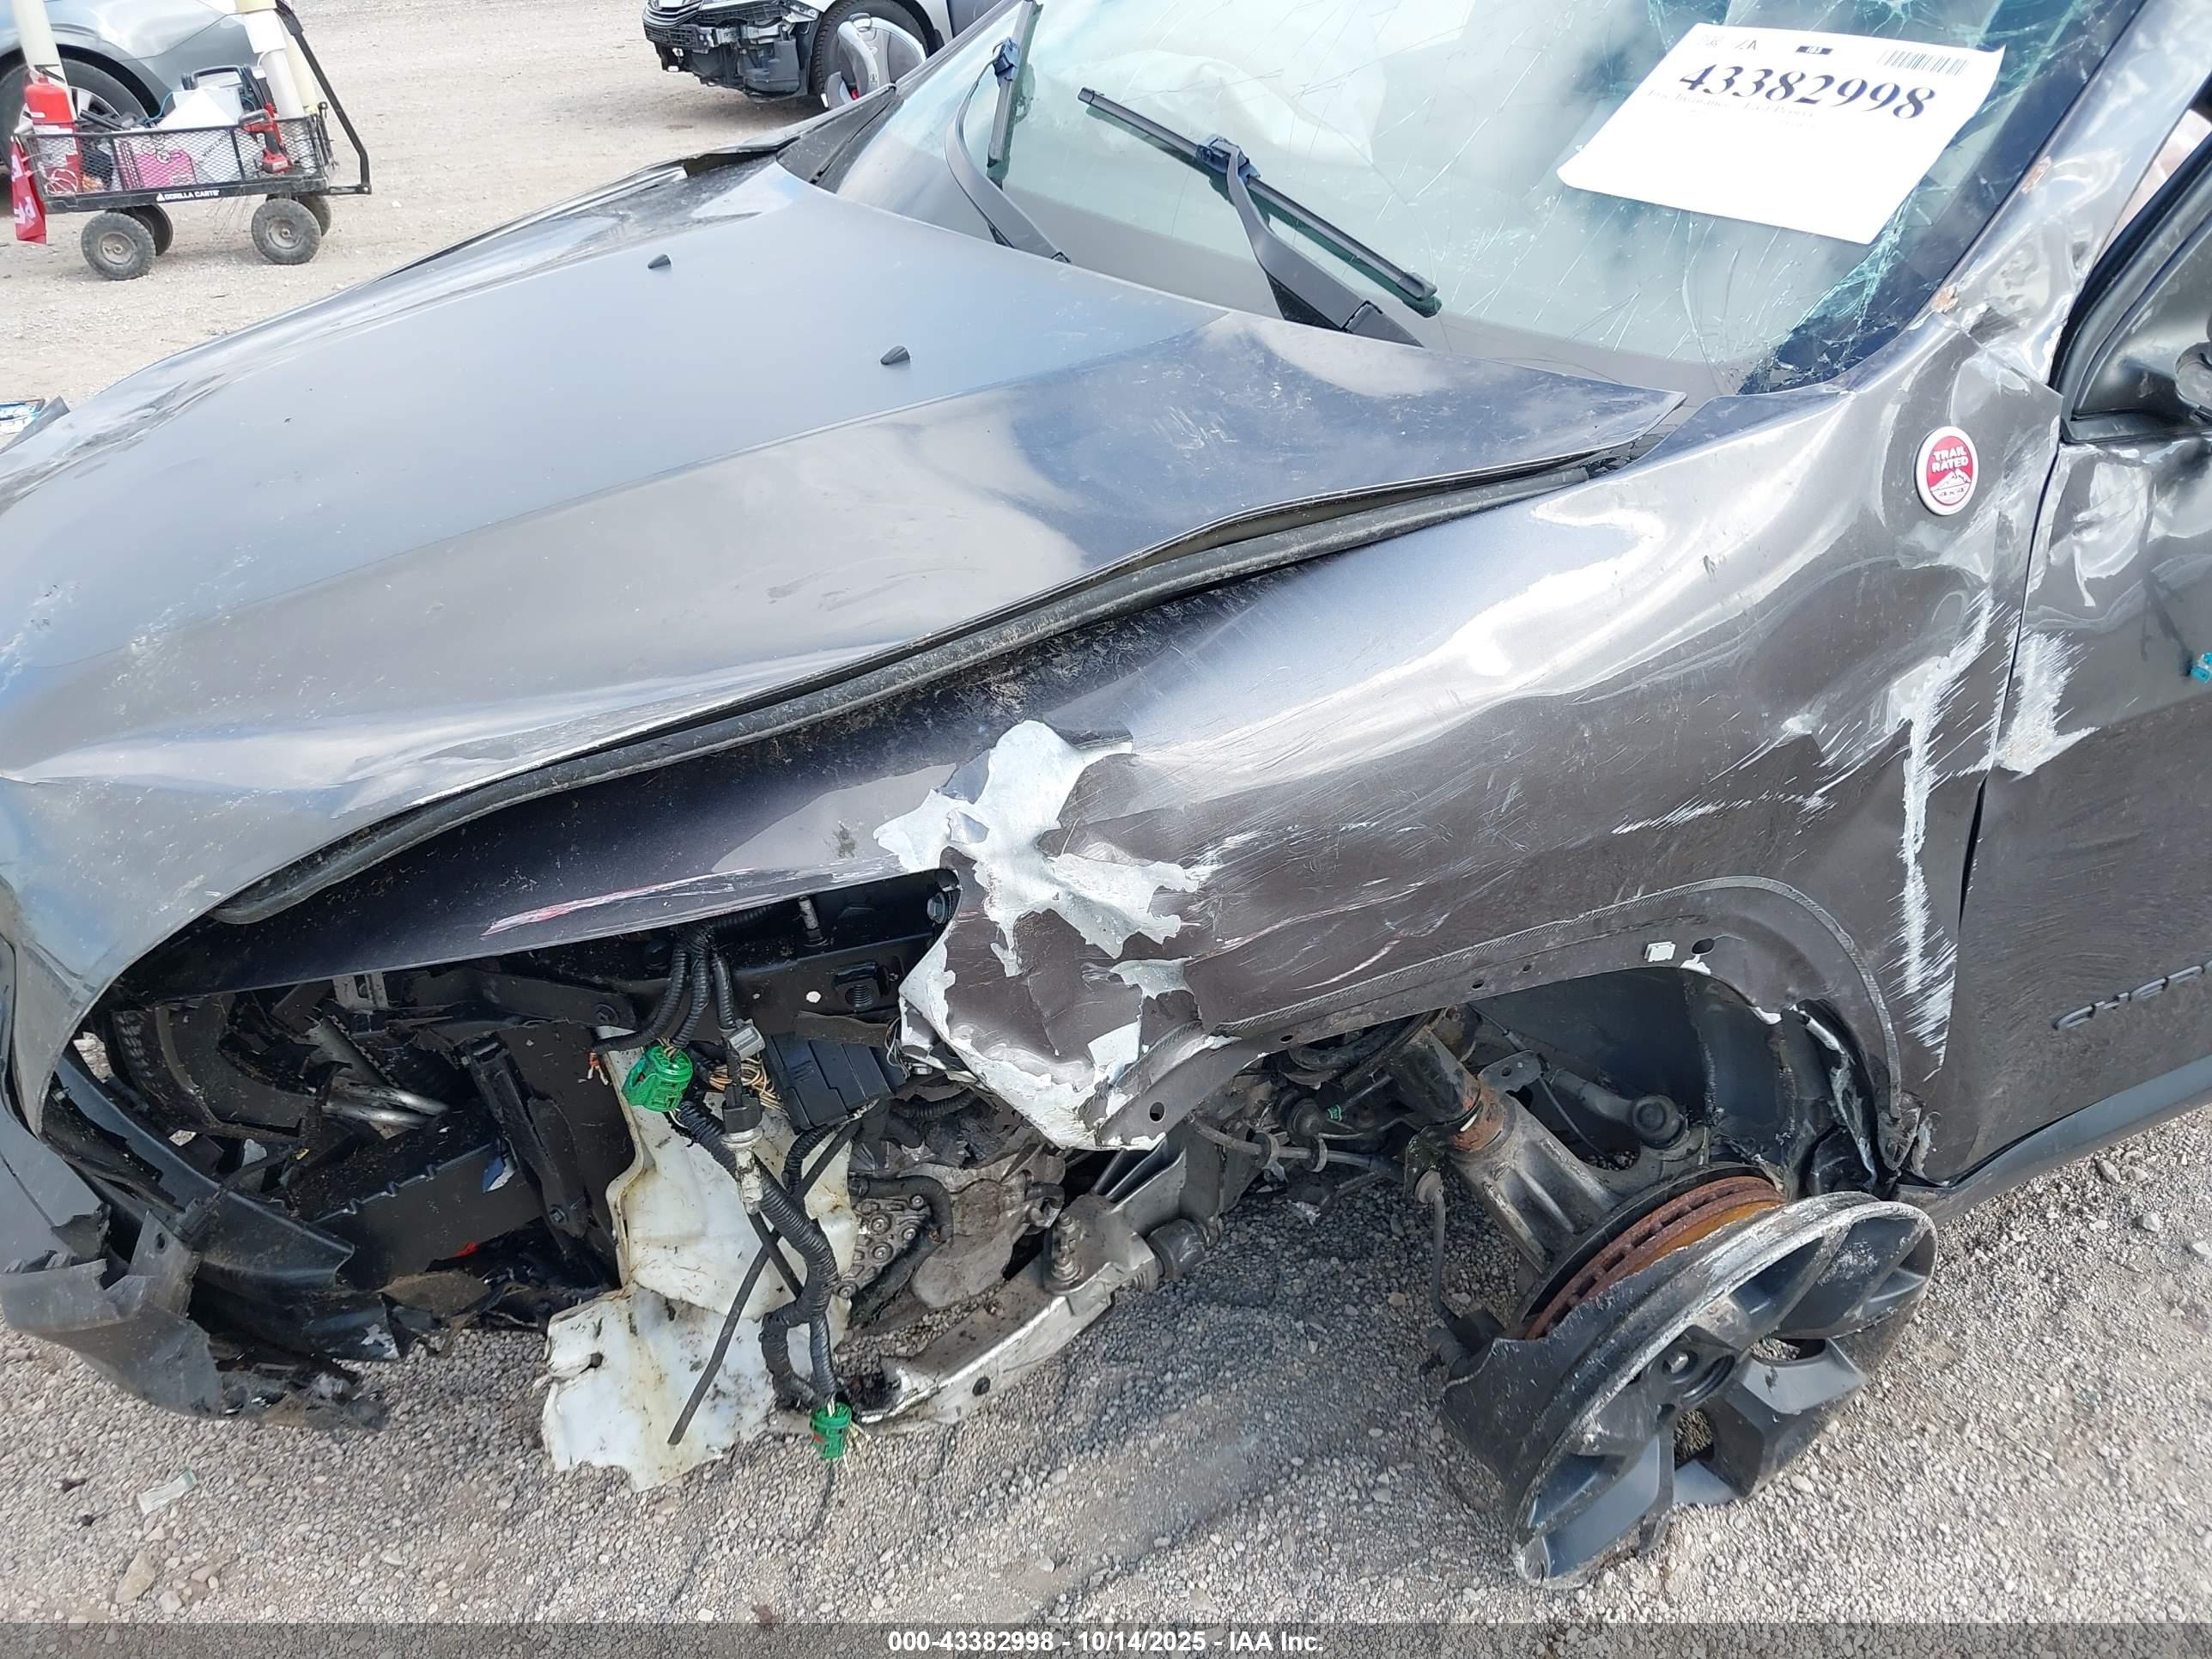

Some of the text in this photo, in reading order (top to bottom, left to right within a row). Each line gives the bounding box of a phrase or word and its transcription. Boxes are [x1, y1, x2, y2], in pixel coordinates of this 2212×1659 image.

[1680, 64, 1936, 119] 43382998
[1933, 446, 1967, 462] TRAIL
[1931, 456, 1969, 473] RATED
